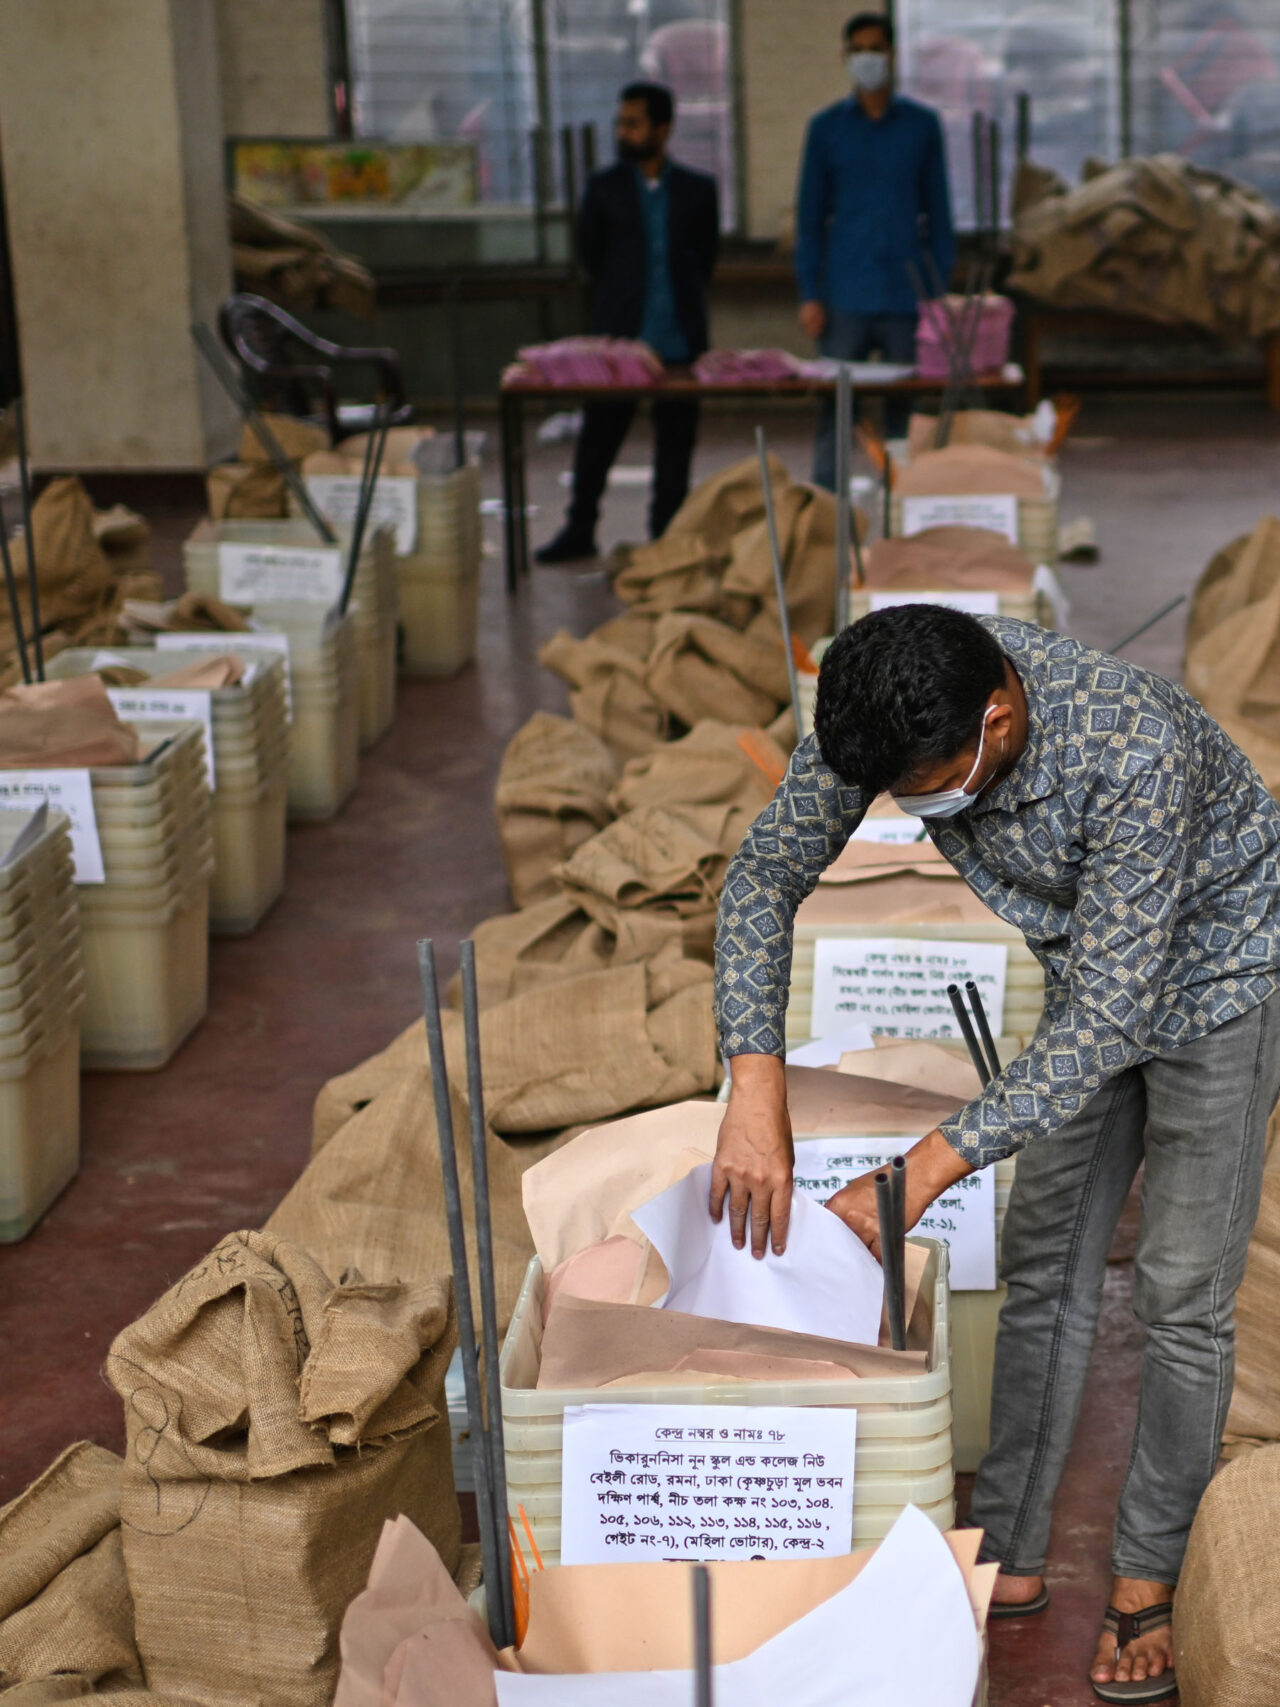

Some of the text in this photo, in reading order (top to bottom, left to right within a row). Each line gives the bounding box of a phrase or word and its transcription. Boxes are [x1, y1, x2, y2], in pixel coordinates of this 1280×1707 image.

[655, 1427, 684, 1440] কেন্দ্র
[688, 1427, 714, 1440] নম্বর
[719, 1428, 729, 1439] ও
[768, 1429, 786, 1441] ৭৮
[760, 1455, 799, 1468] কলেজ
[803, 1452, 825, 1468] নিউ
[665, 1474, 700, 1489] রমনা,
[705, 1475, 733, 1487] ঢাকা
[816, 1477, 843, 1489] ভবন
[693, 1495, 717, 1507] তলা
[722, 1496, 747, 1508] কক্ষ
[751, 1497, 766, 1508] নং
